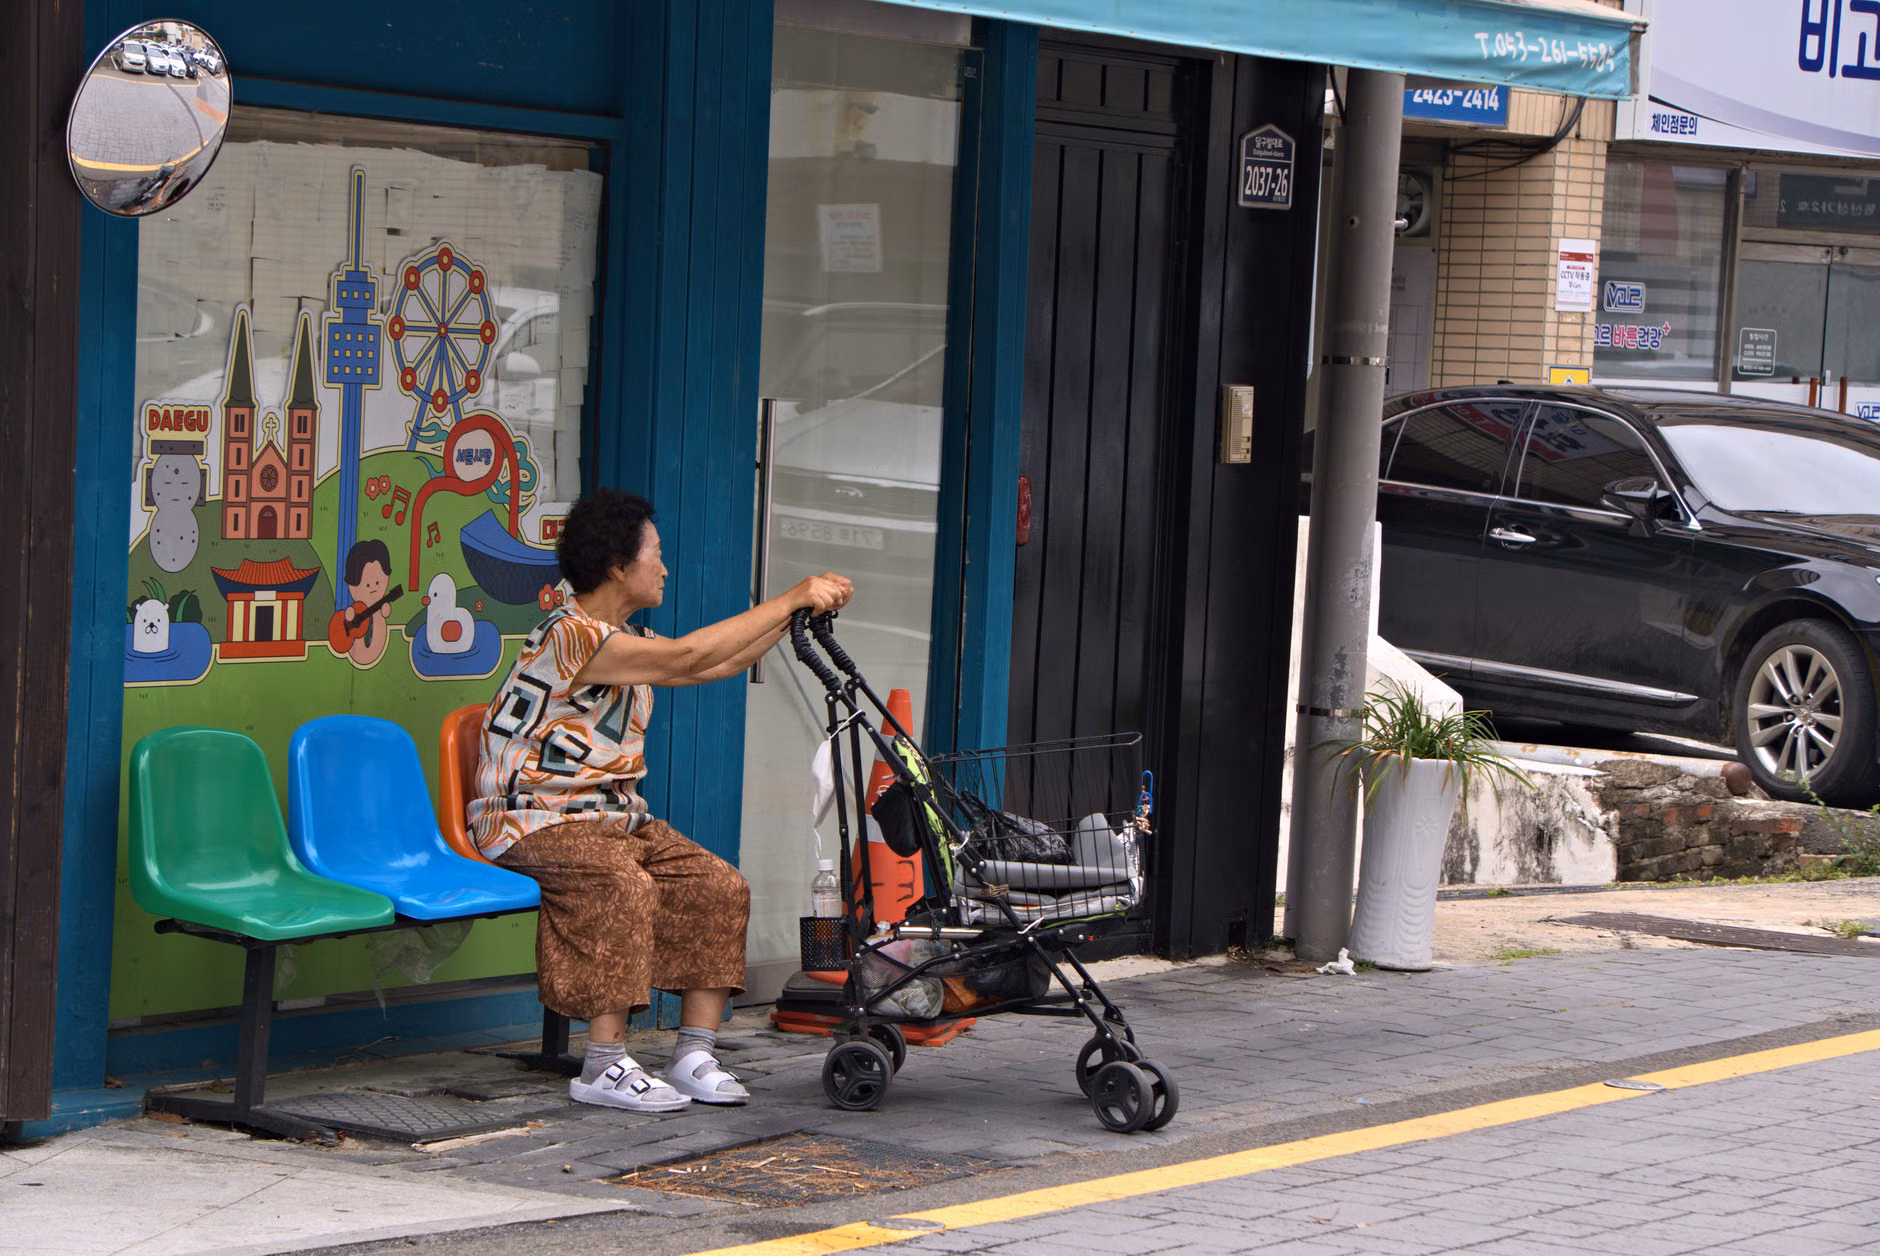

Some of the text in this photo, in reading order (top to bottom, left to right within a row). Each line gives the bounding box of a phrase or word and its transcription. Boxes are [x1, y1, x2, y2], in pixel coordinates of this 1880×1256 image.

[1651, 112, 1698, 136] 체인점문의
[1244, 165, 1288, 197] 2037-26
[1613, 324, 1662, 349] 바른건강
[148, 408, 209, 432] DAEGU
